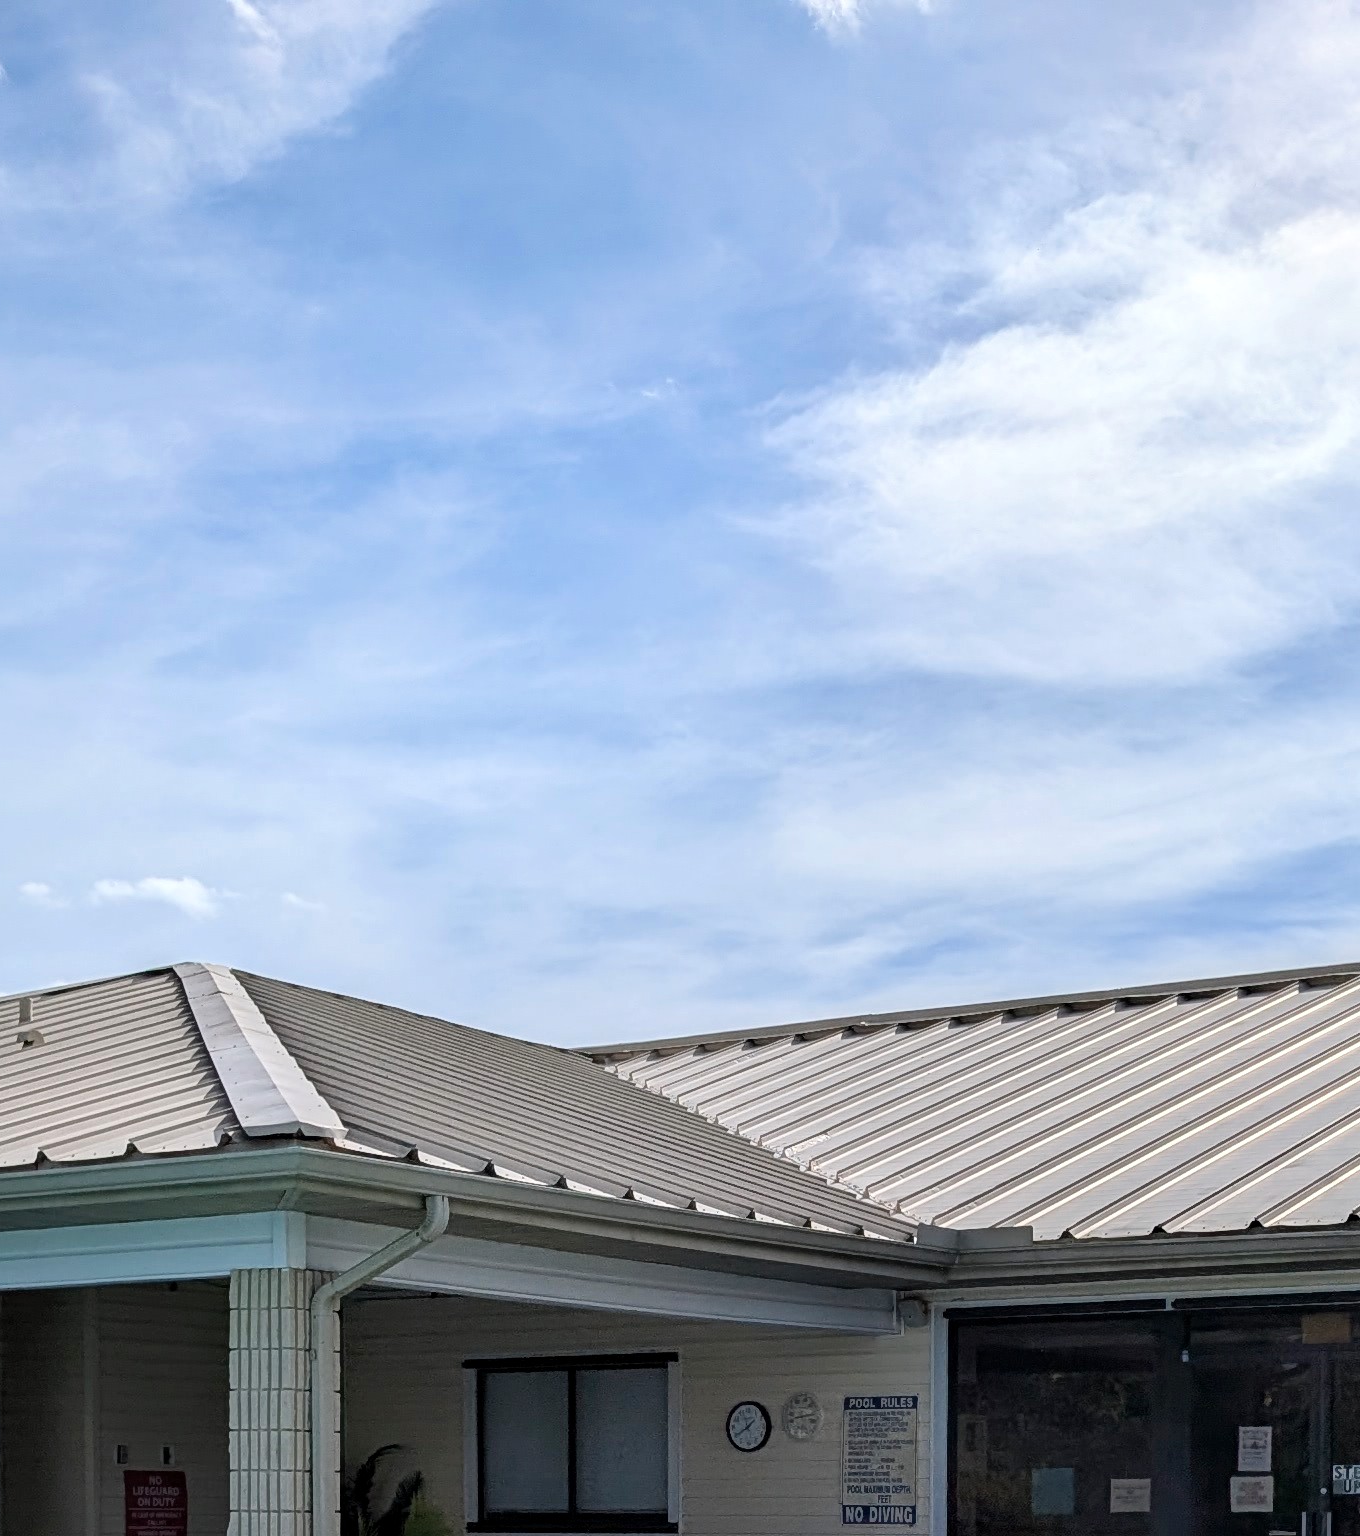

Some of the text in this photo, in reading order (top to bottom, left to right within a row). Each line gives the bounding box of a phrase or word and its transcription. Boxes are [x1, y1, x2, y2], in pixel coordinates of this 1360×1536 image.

[849, 1397, 913, 1408] POOL RULES
[149, 1475, 163, 1485] NO
[132, 1486, 180, 1496] LIFEGUARD
[847, 1485, 862, 1494] POOL
[137, 1497, 176, 1507] ON DUTY
[877, 1495, 892, 1504] FEET
[845, 1506, 913, 1523] NO DIVING
